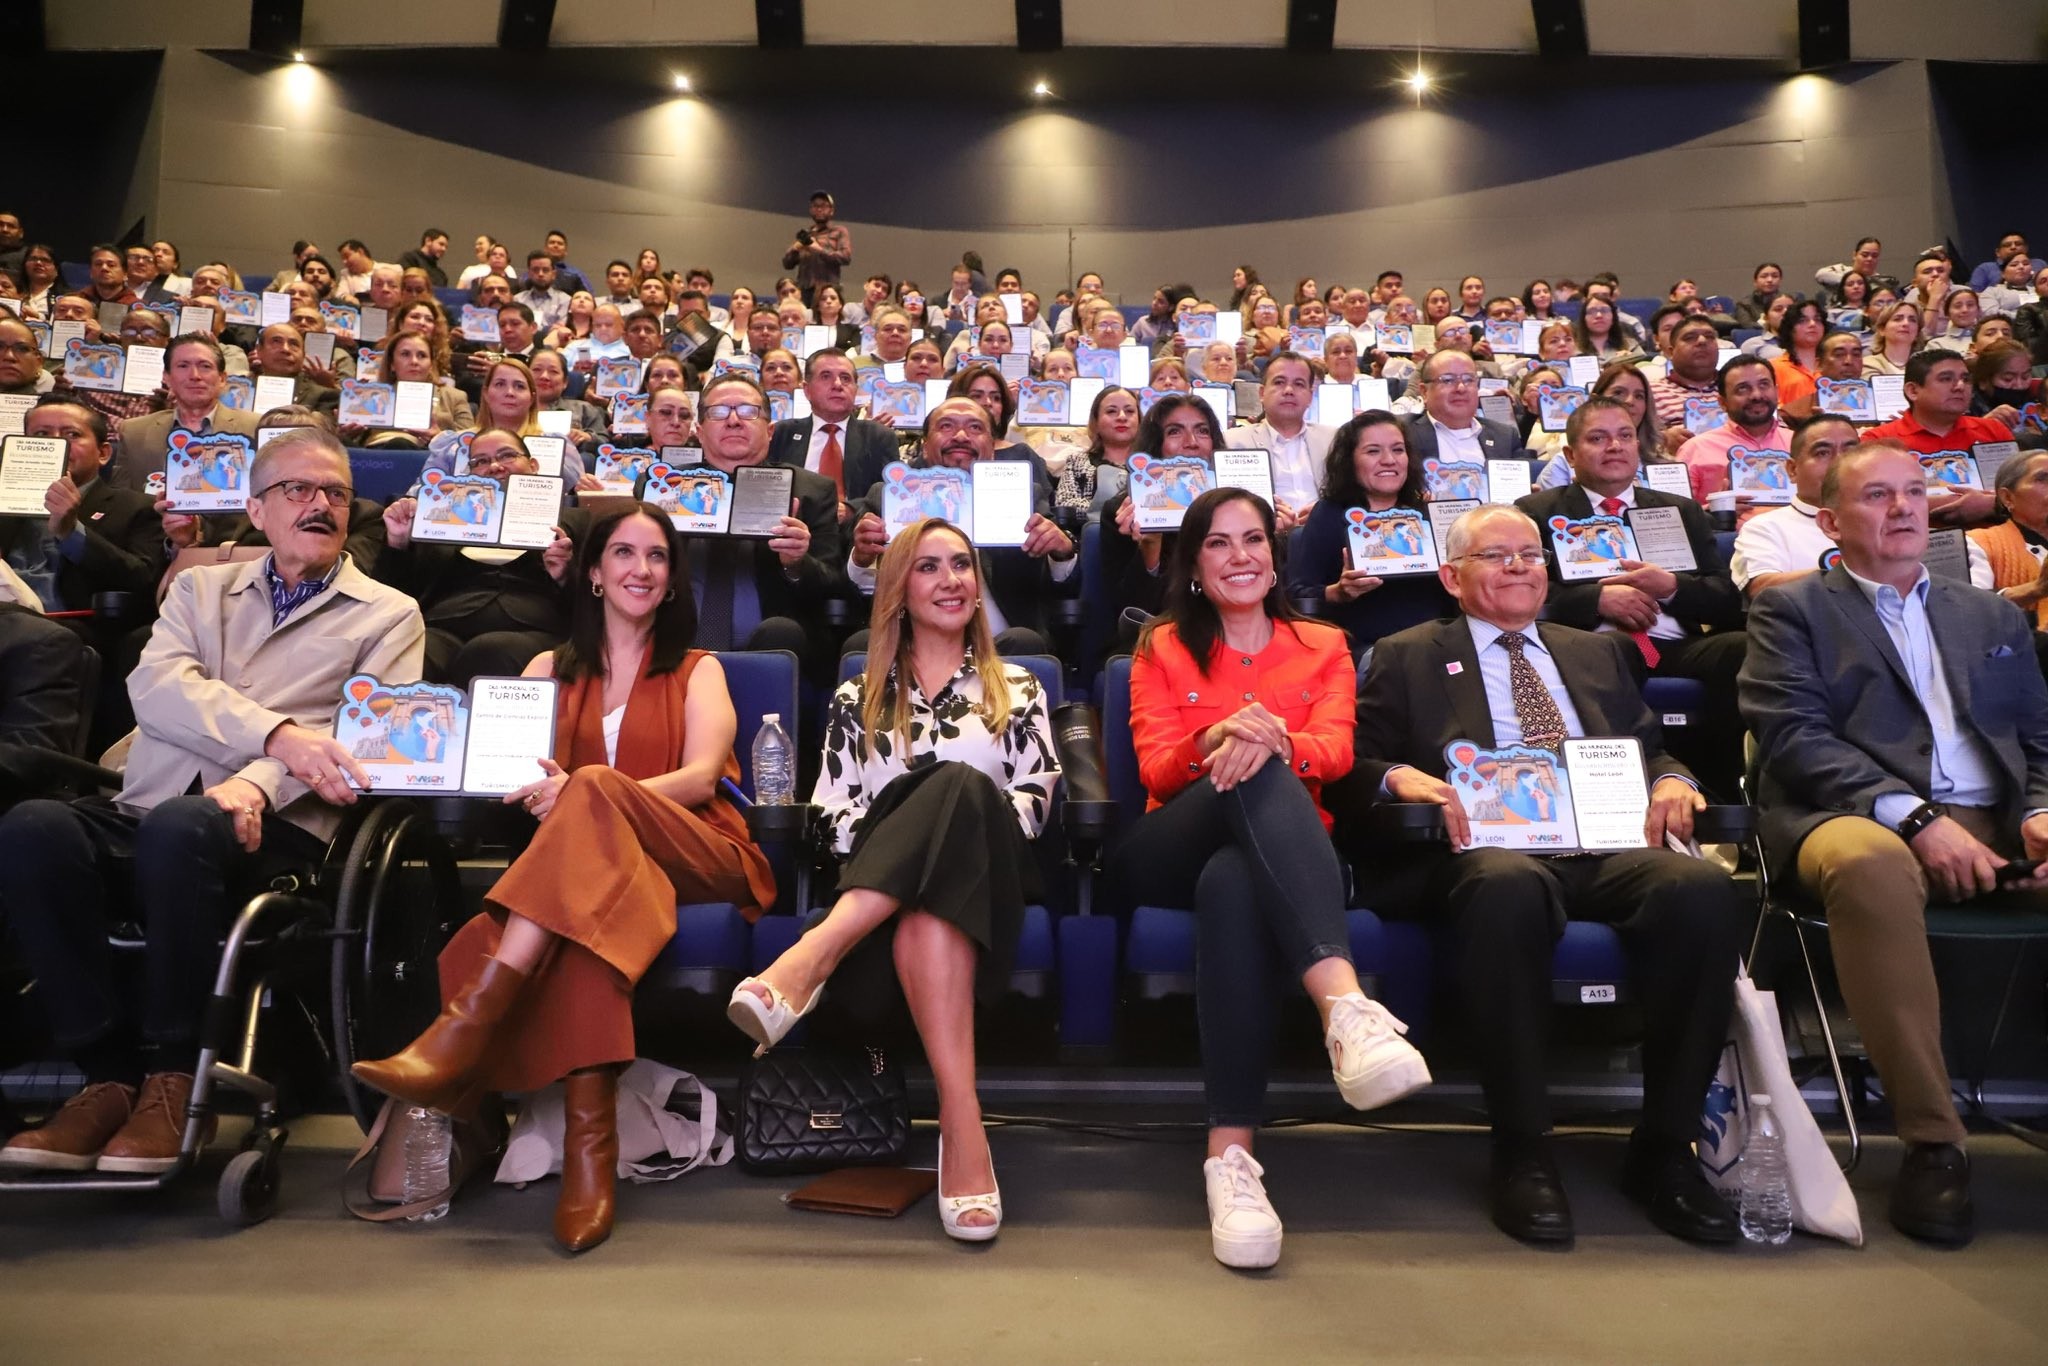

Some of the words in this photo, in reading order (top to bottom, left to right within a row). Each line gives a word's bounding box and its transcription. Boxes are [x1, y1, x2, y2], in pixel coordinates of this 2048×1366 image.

[488, 692, 540, 700] TURISMO
[1579, 750, 1627, 759] TURISMO
[1589, 989, 1608, 998] A13
